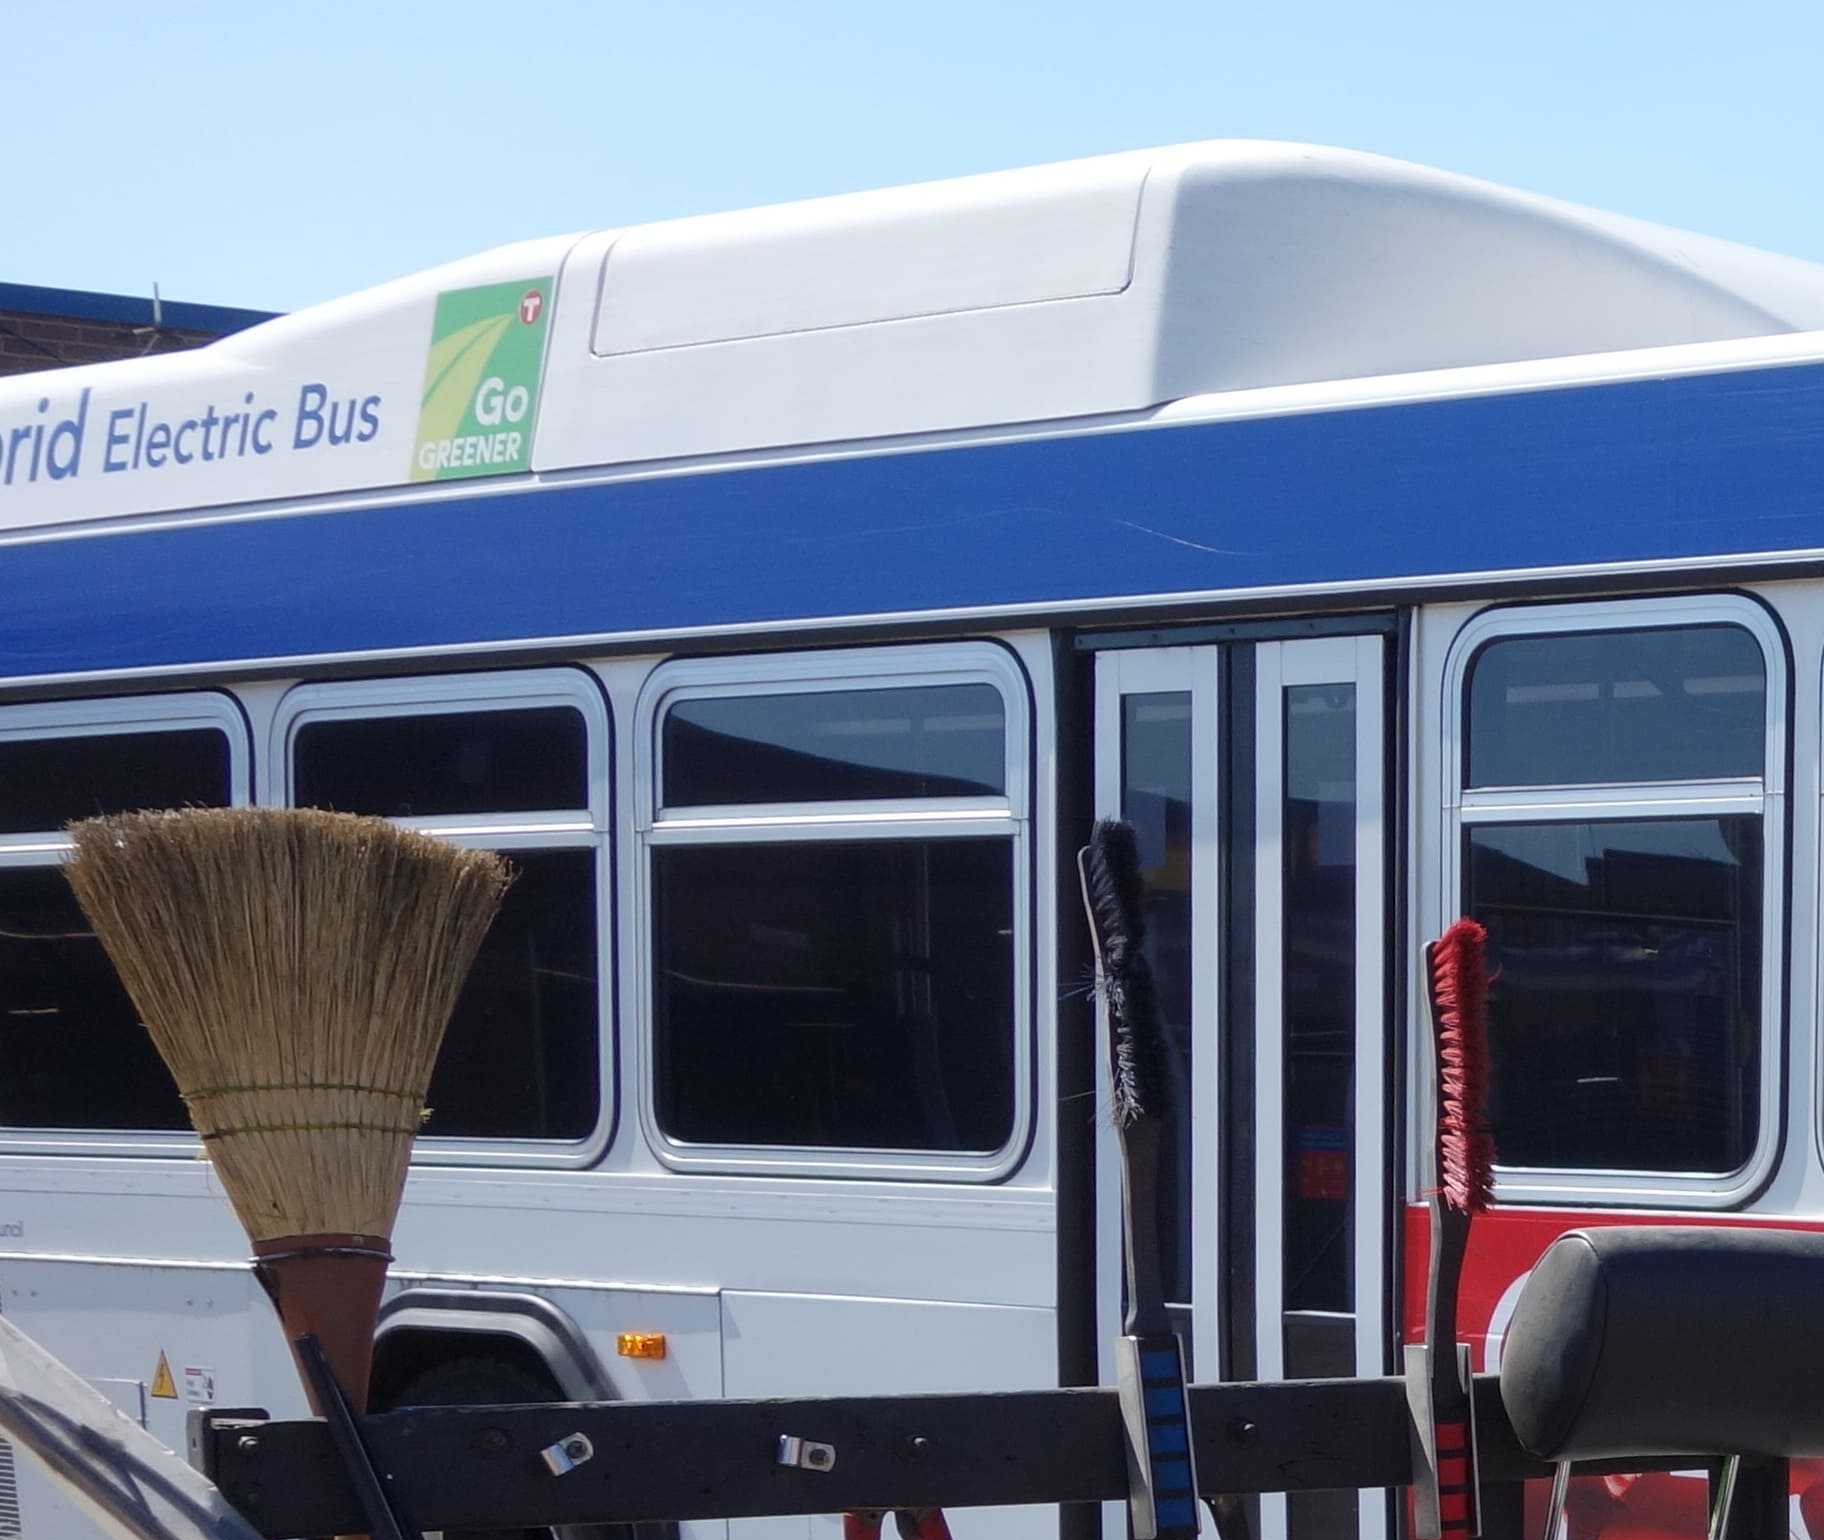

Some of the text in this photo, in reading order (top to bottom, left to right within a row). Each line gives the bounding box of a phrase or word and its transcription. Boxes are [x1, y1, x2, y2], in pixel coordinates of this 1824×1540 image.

[475, 376, 529, 426] Go
[0, 382, 382, 486] rid Electric Bus
[418, 431, 522, 470] GREENER
